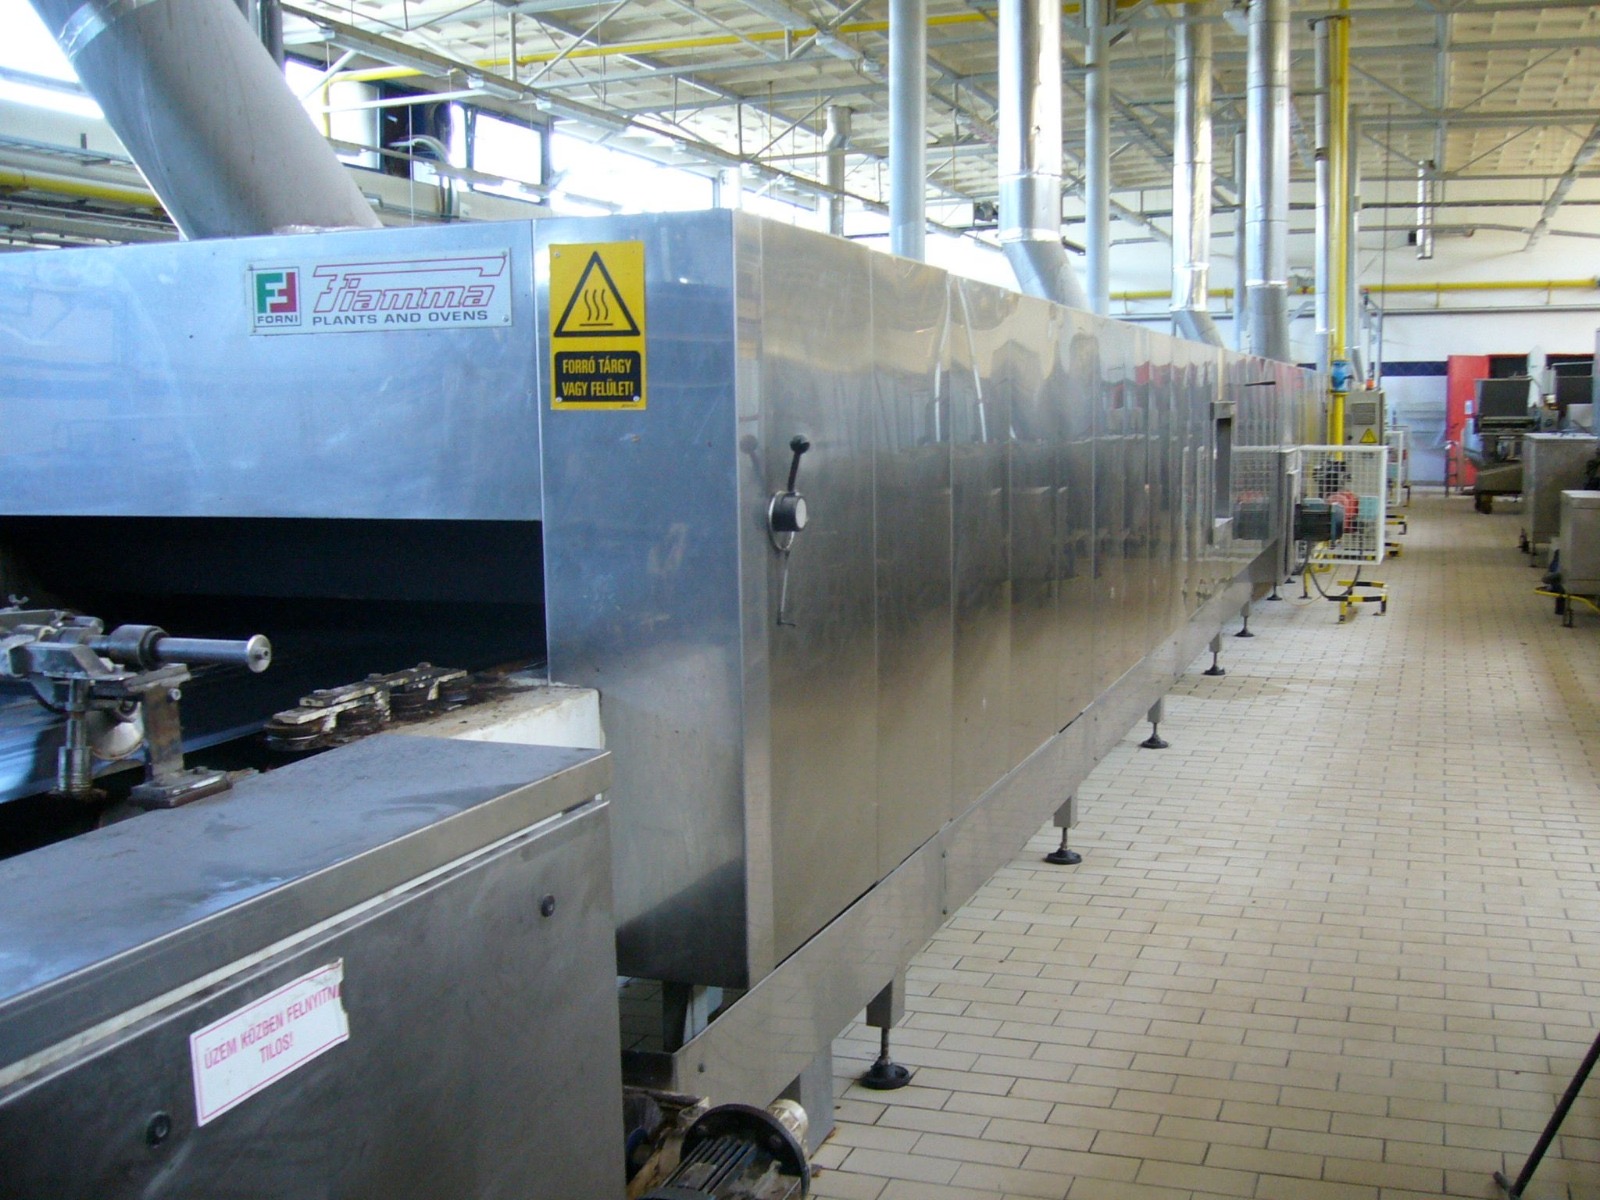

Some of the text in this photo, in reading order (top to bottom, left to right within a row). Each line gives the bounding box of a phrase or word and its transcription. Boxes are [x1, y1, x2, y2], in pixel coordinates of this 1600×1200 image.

[312, 255, 506, 314] Fiamma
[257, 314, 299, 324] FORNI
[312, 309, 488, 326] PLANTS AND OVENS
[562, 355, 632, 374] FORRÓ TÁRGY
[561, 378, 634, 397] VAGY FELÜLET!
[204, 1037, 238, 1069] ÜZEM
[239, 1012, 284, 1050] KÖZBEN
[259, 1031, 295, 1064] TILOS!
